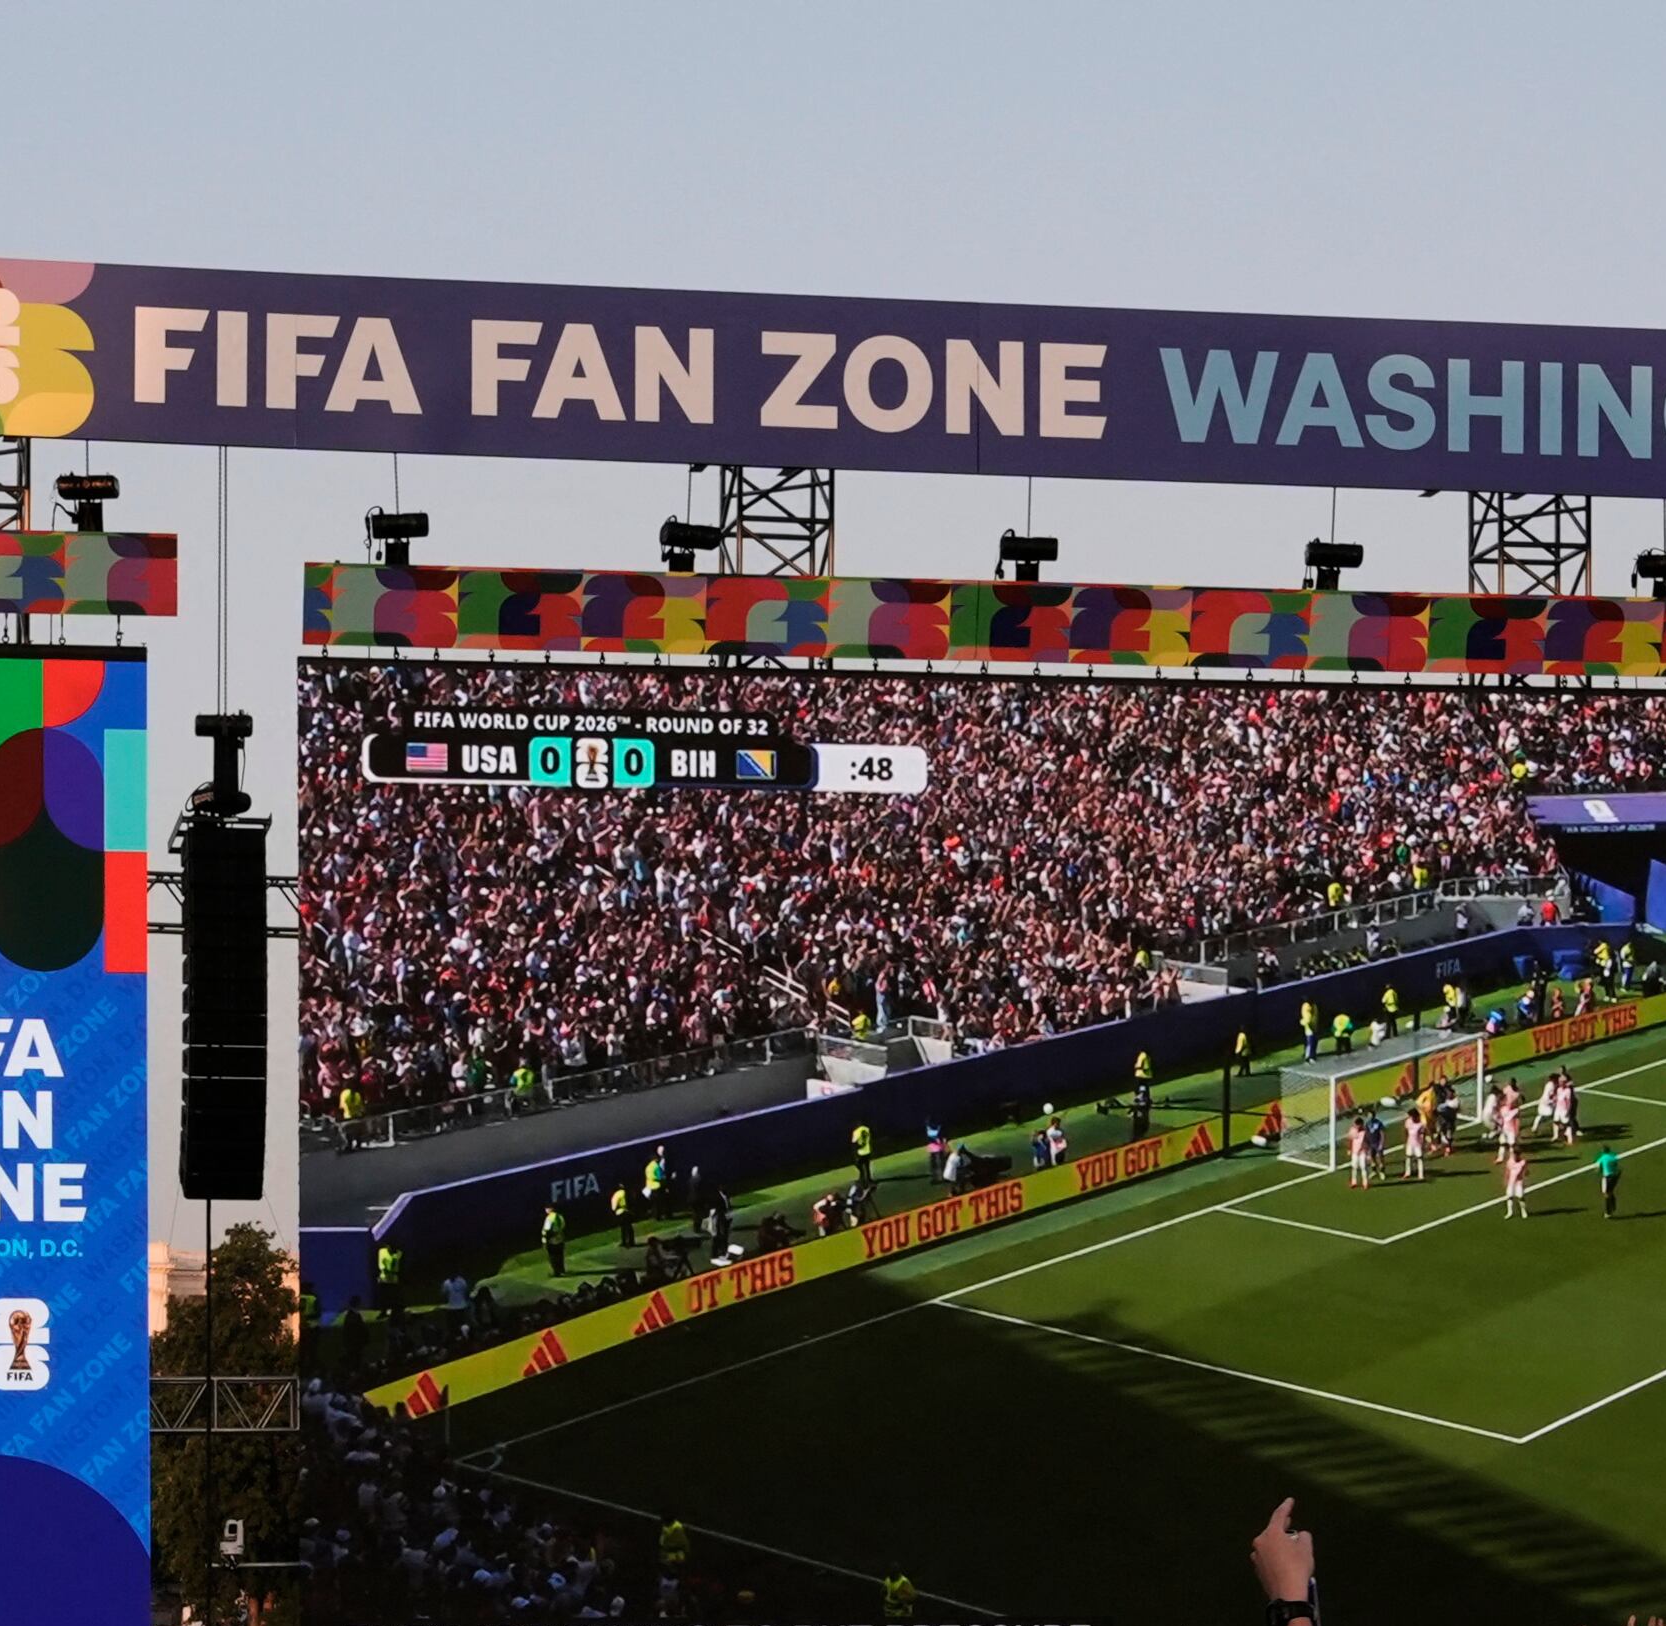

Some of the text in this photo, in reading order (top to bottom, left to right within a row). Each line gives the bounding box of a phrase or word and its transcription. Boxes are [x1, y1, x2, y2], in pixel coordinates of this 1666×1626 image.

[134, 306, 422, 414] FIFA
[471, 319, 713, 424] FAN
[760, 332, 1107, 439] ZONE
[413, 711, 456, 729] FIFA
[459, 712, 529, 730] WORLD
[533, 715, 571, 731] CUP
[646, 717, 716, 734] ROUND
[719, 717, 743, 734] OF
[746, 718, 770, 735] 32
[461, 745, 893, 783] USA 0 0 BIH :48
[1436, 960, 1462, 978] FIFA
[1532, 1024, 1565, 1054] YOU
[1603, 1004, 1637, 1036] THIS
[64, 1103, 112, 1149] FAN
[551, 1172, 600, 1201] FIFA
[1076, 1138, 1163, 1191] YOU GOT
[862, 1182, 1023, 1259] YOU GOT THIS
[40, 1239, 83, 1257] D.C.
[728, 1249, 794, 1301] THIS
[6, 1372, 33, 1381] FIFA
[28, 1386, 76, 1437] FAN
[76, 1331, 134, 1394] ZONE
